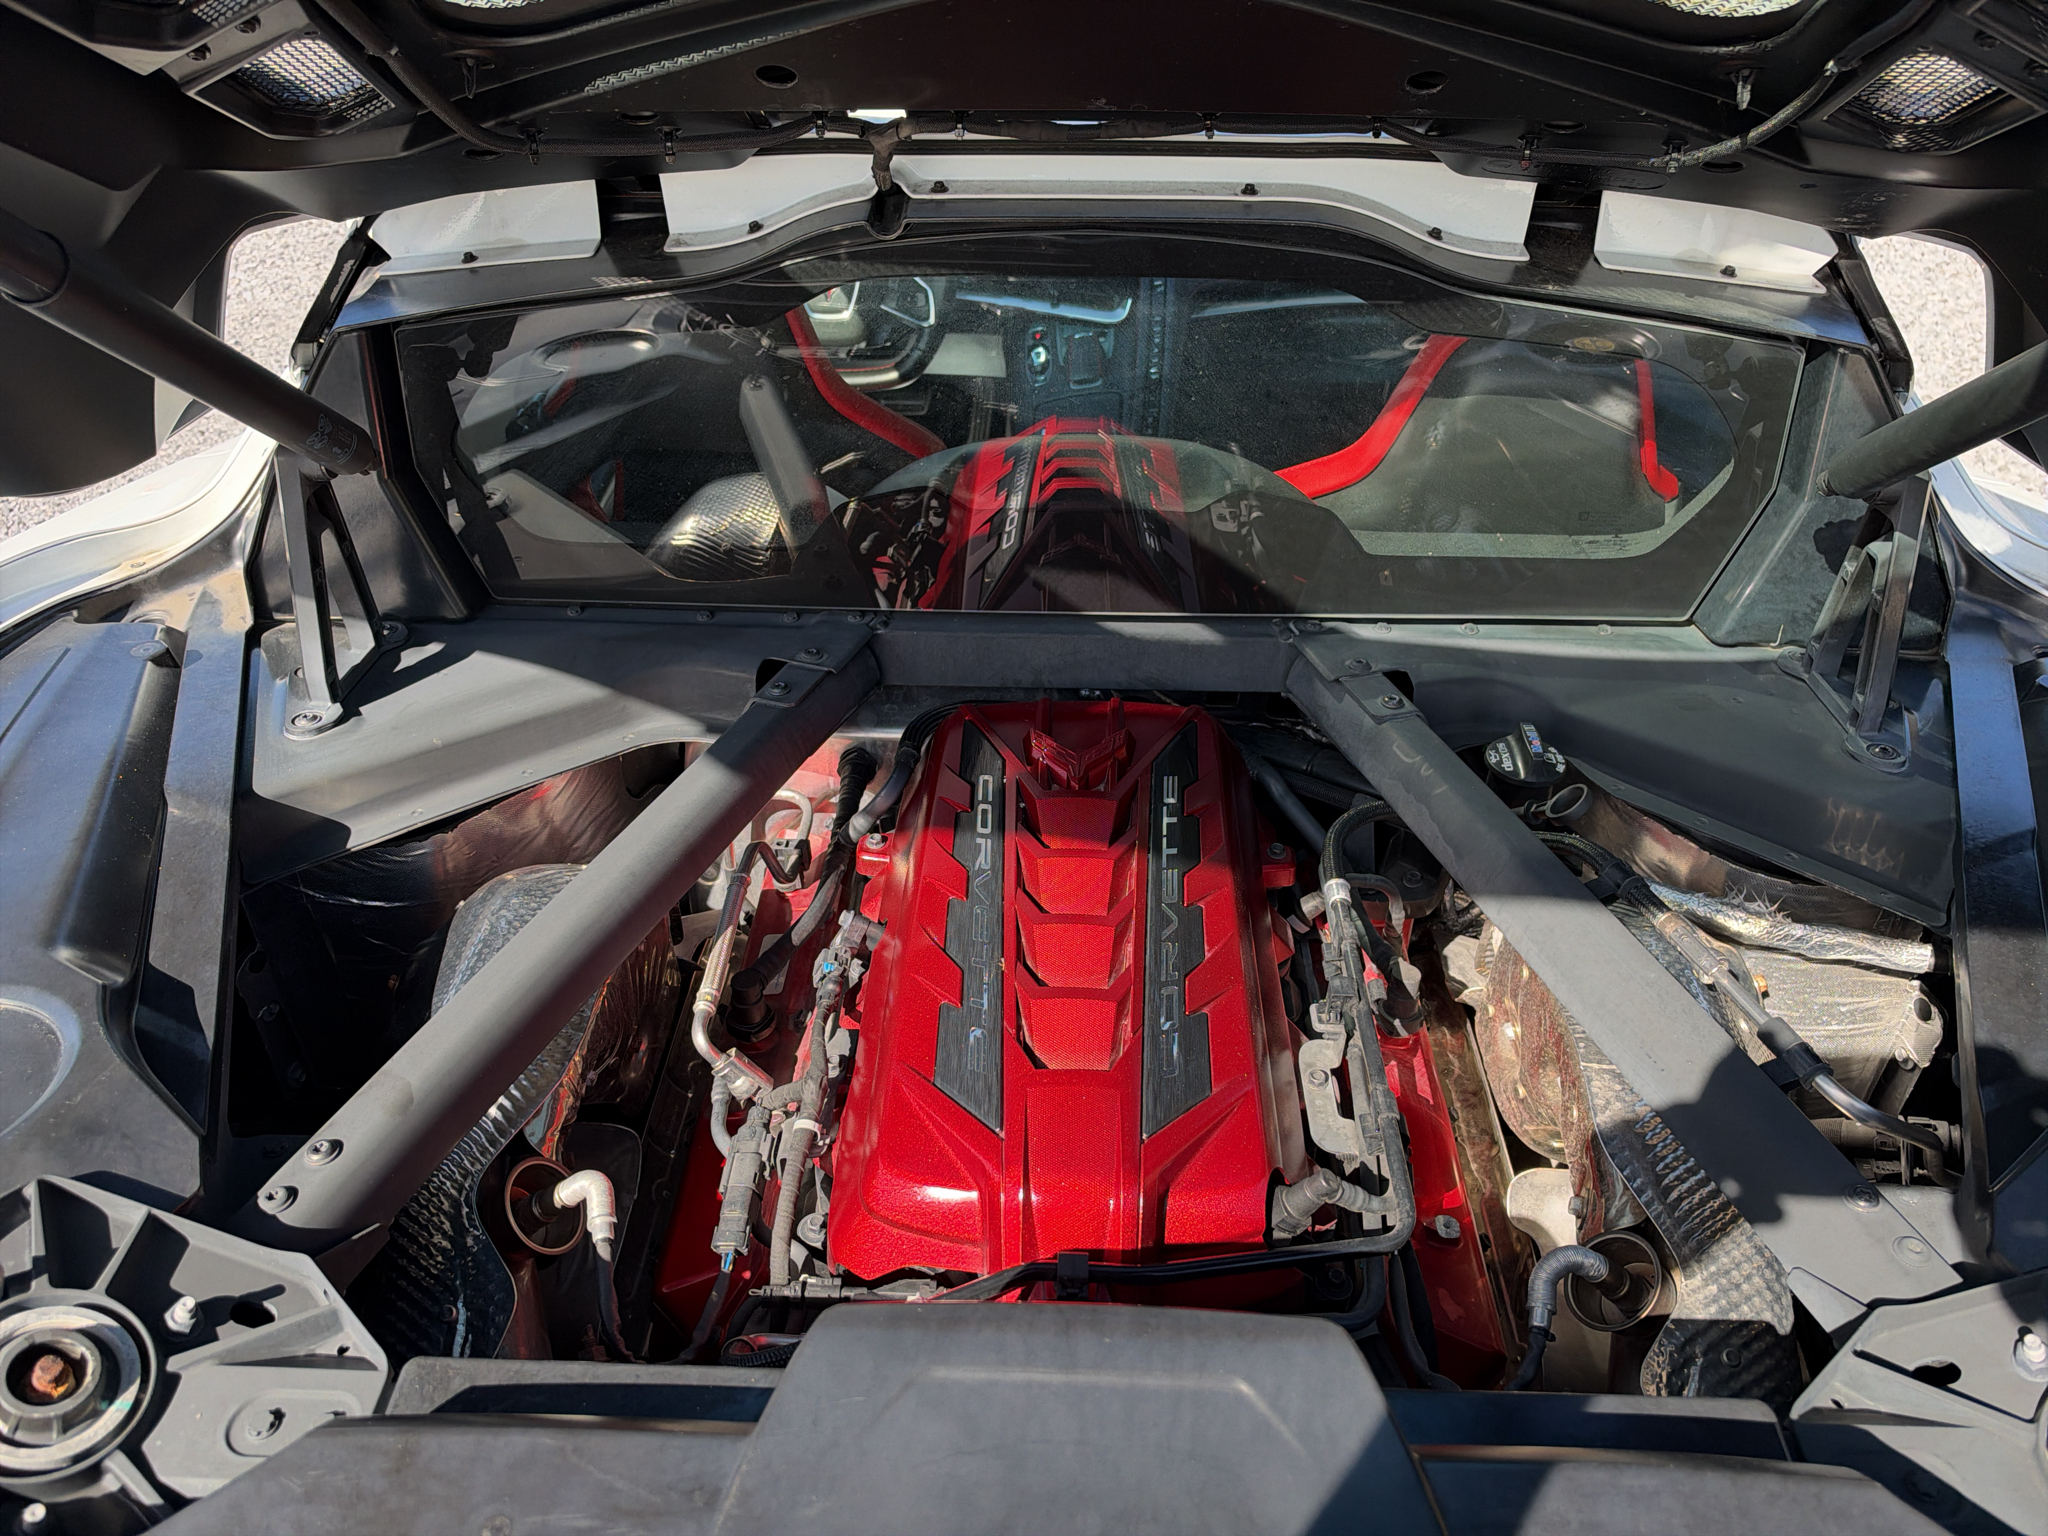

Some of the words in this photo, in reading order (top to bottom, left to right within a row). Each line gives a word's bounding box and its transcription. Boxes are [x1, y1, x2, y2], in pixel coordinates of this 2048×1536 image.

[1497, 743, 1514, 771] dexos
[968, 774, 994, 1075] CORVETTE
[1160, 775, 1179, 1078] CORVETTE
